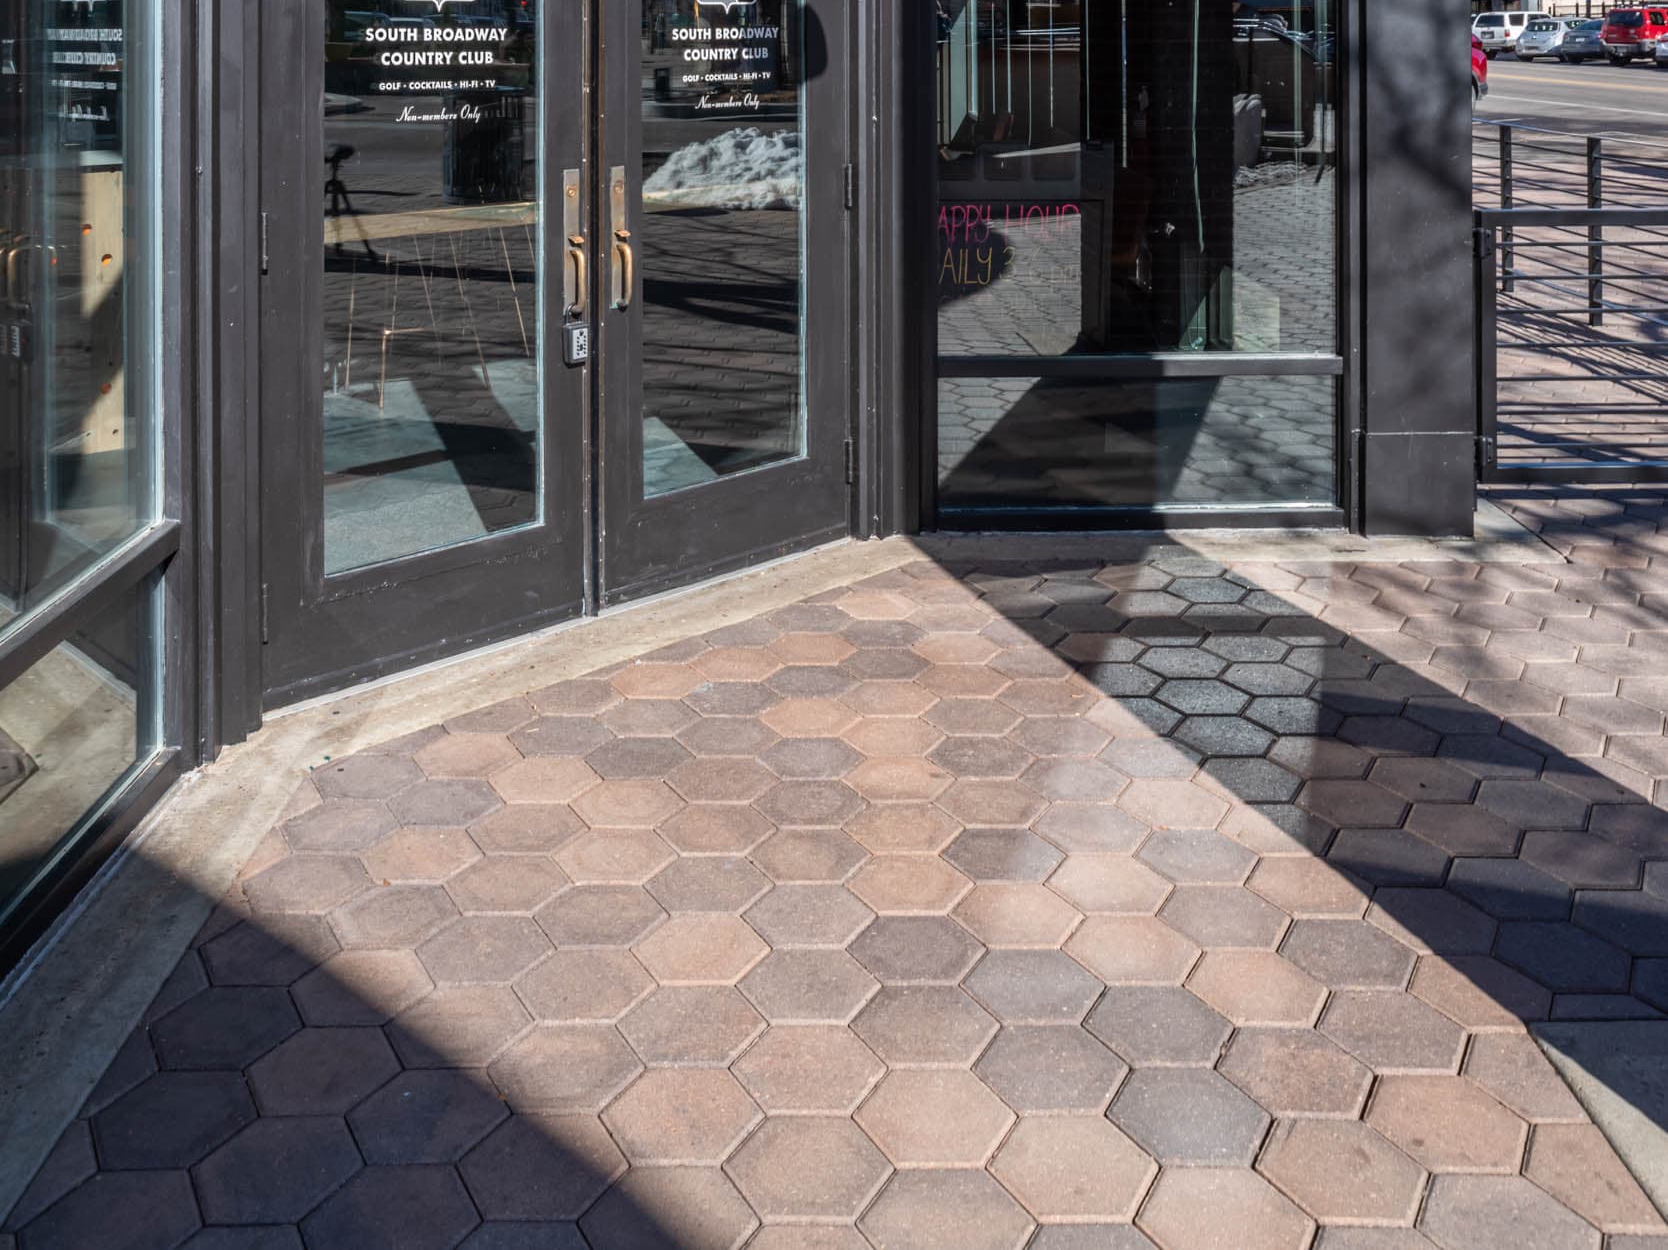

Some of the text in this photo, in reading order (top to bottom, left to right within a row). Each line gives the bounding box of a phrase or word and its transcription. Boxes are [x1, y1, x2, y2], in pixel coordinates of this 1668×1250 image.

[365, 28, 508, 41] SOUTH BROADWAY
[672, 27, 779, 40] SOUTH BROADWAY
[381, 51, 494, 66] COUNTRY CLUB
[684, 48, 769, 61] COUNTRY CLUB
[682, 74, 700, 83] GOLF
[705, 73, 738, 82] COCKTAILS
[379, 79, 496, 91] GOLF COCKTAILS HI-FI TV
[743, 93, 760, 110] Only
[396, 103, 480, 124] Non-members Only
